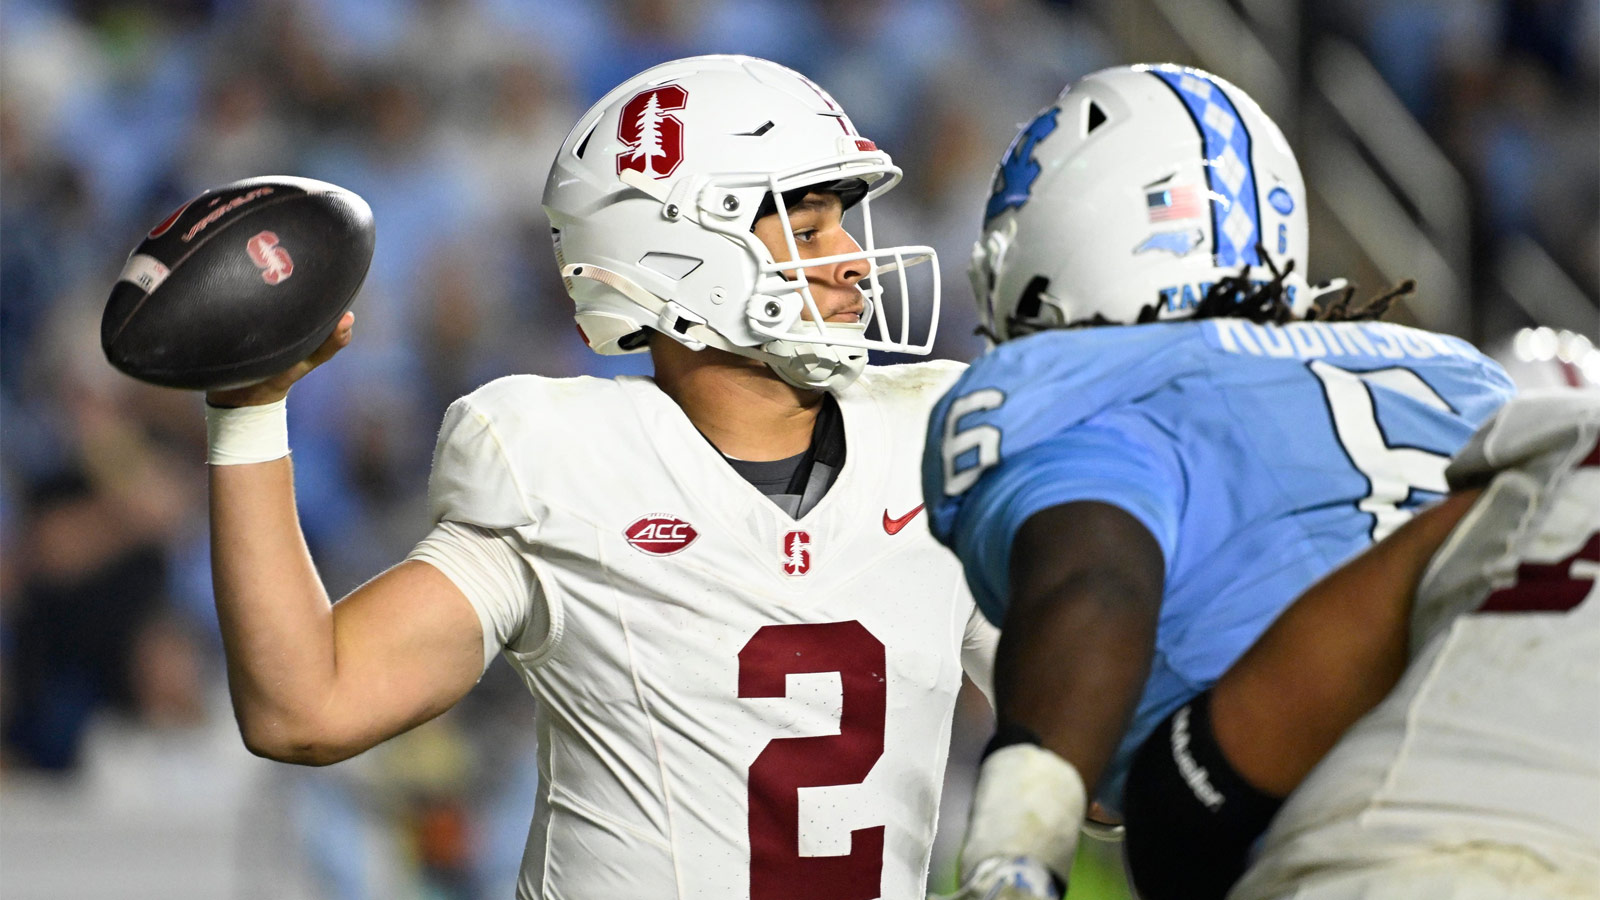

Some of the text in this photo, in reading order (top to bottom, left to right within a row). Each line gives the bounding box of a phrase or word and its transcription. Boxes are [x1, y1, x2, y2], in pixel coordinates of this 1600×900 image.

[1278, 223, 1287, 254] 6
[941, 388, 1006, 497] 6
[633, 523, 689, 539] ACC
[737, 619, 887, 900] 2
